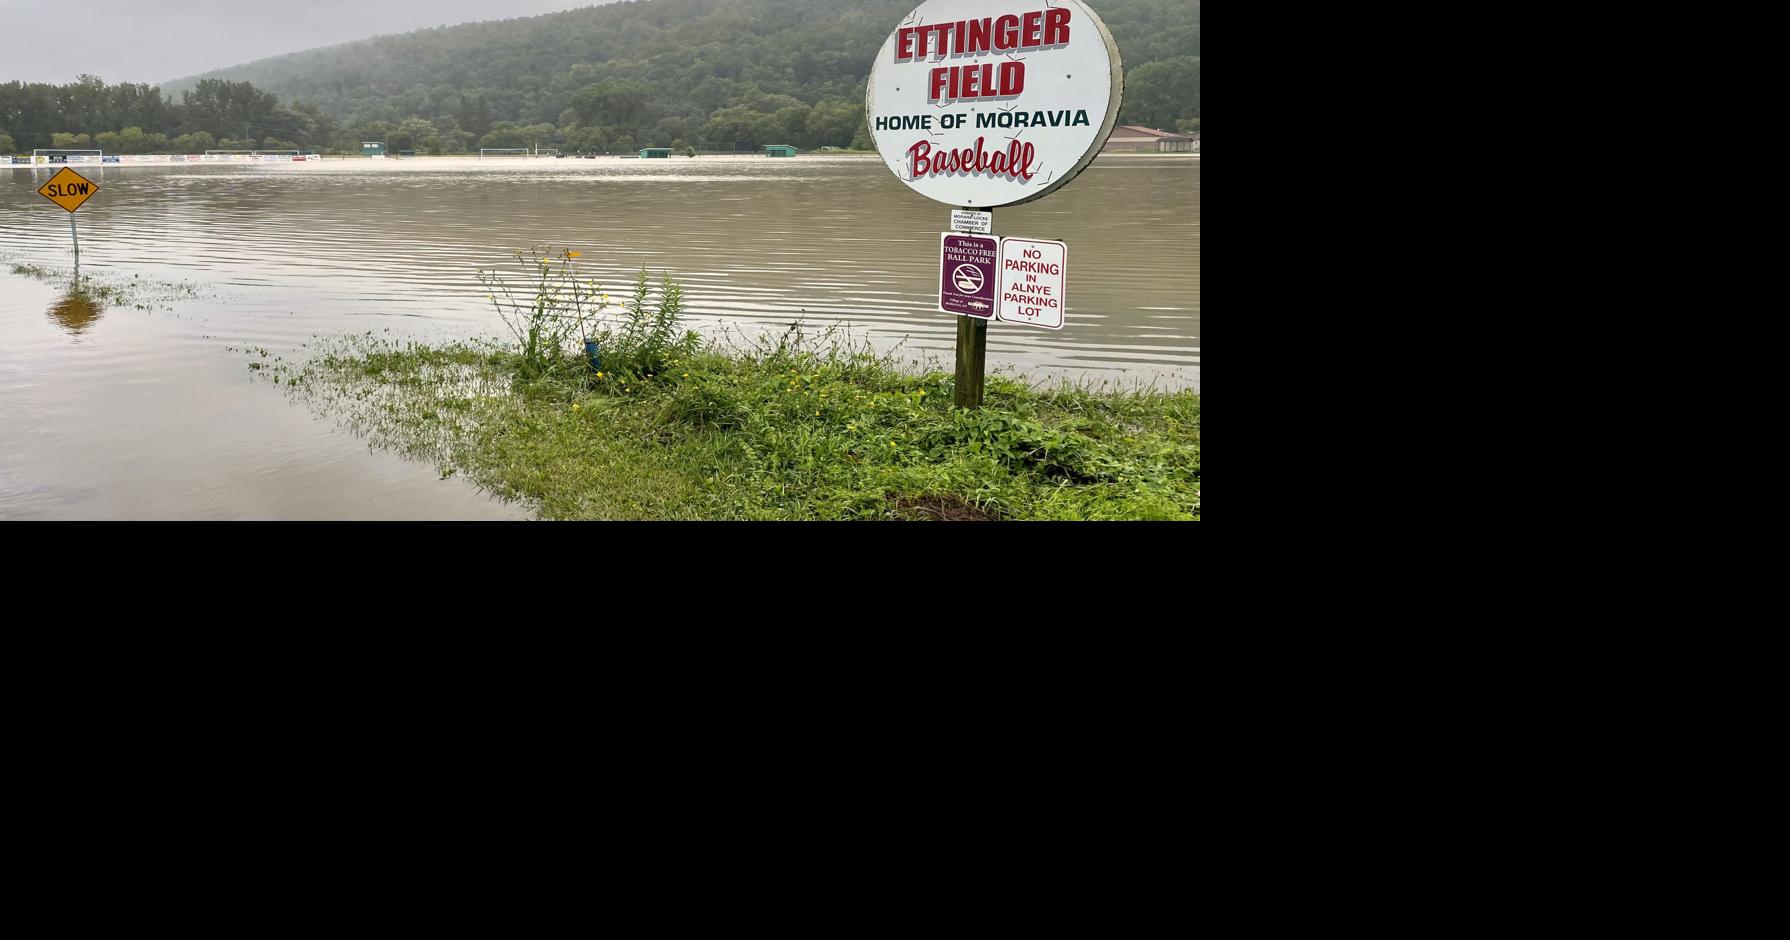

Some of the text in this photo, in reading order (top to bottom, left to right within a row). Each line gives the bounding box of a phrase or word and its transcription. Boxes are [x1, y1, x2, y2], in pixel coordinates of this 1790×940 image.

[895, 8, 1071, 63] ETTINGER
[928, 62, 1025, 103] FIELD
[875, 109, 1090, 131] HOME OF MORAVIA
[906, 136, 1035, 184] Baseball
[48, 183, 89, 197] SLOW
[944, 246, 996, 258] TOBACCO FREE
[947, 253, 991, 265] BALL PARK
[1023, 249, 1042, 260] NO
[1005, 259, 1059, 276] PARKING
[1025, 274, 1037, 283] IN
[1011, 282, 1051, 296] ALNYE
[1004, 292, 1058, 308] PARKING
[1018, 306, 1042, 317] LOT
